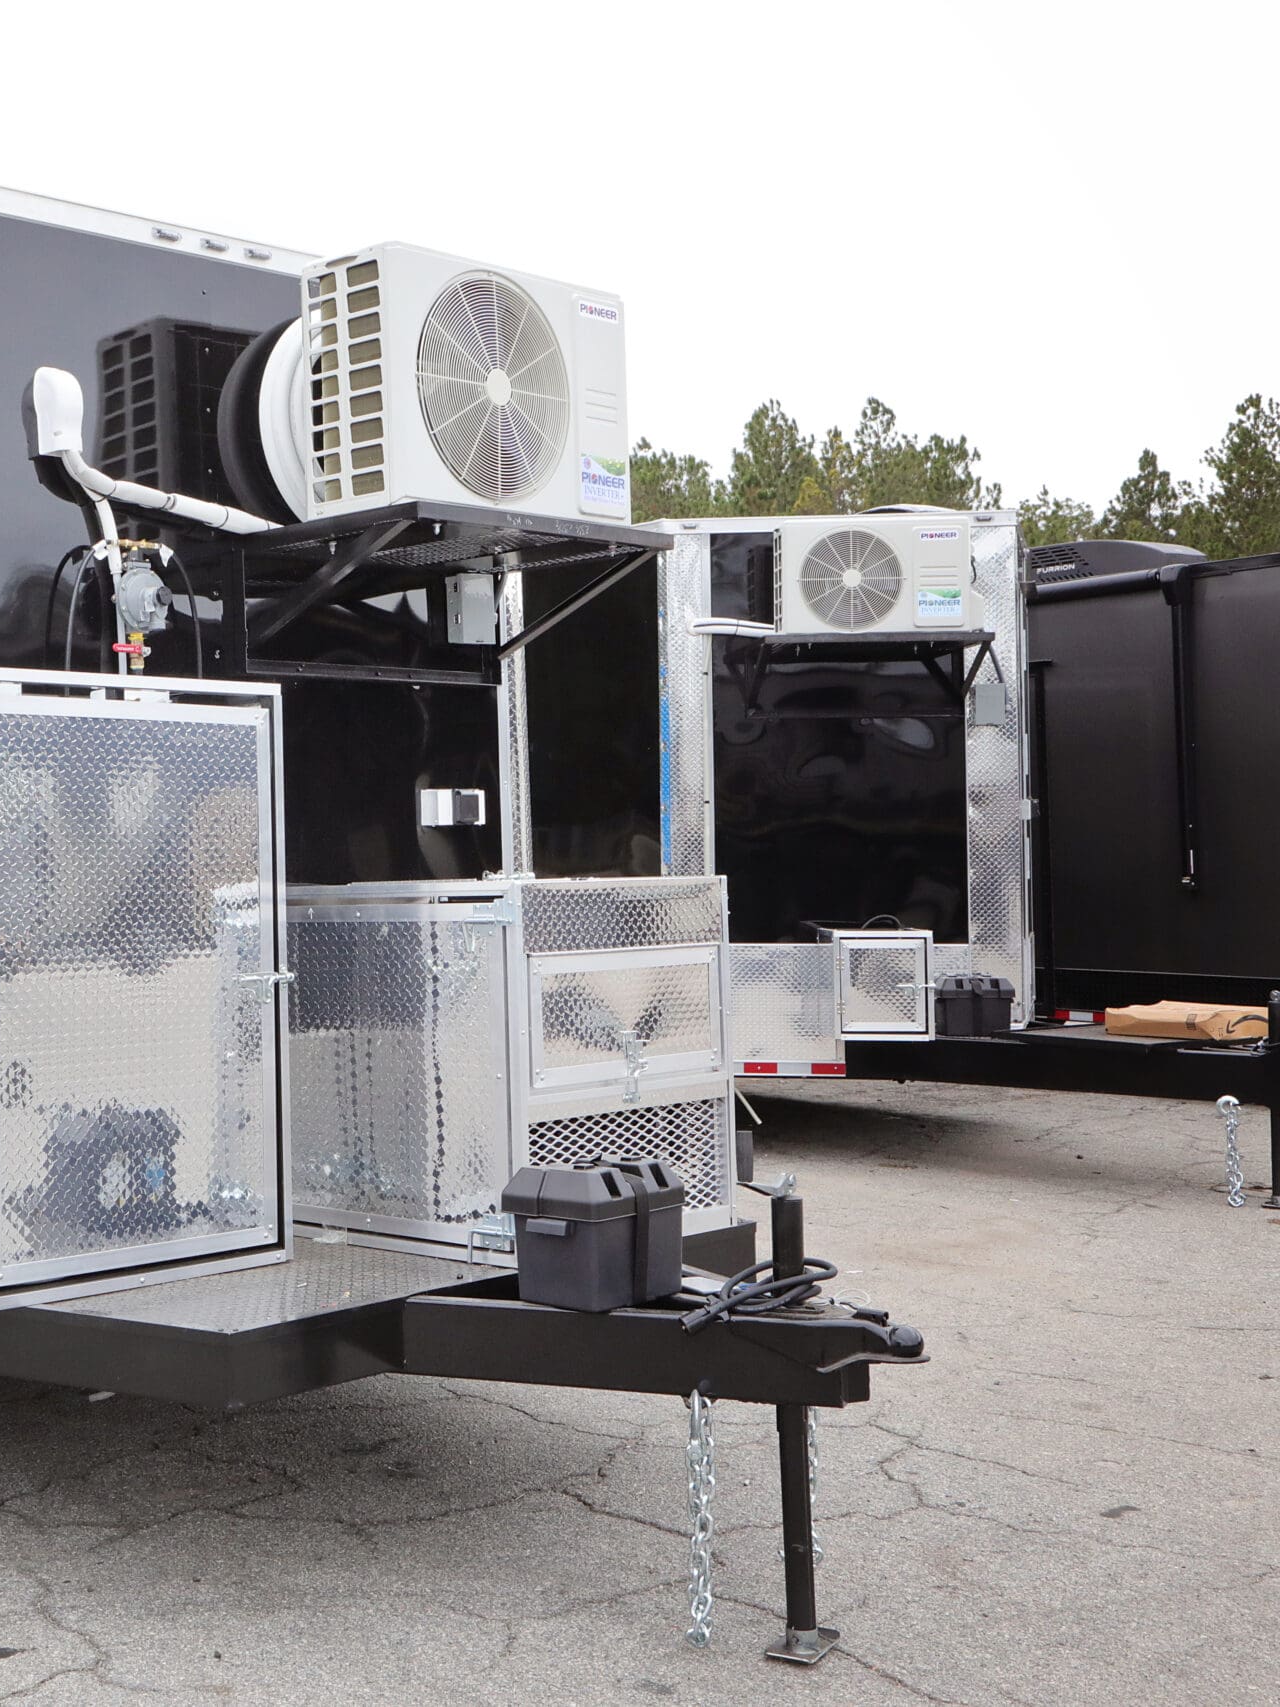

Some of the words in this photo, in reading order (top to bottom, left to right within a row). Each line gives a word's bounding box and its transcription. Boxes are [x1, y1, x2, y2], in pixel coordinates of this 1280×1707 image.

[580, 303, 617, 320] PIONEER
[581, 471, 625, 490] PIONEER
[920, 531, 957, 539] PIONEER
[1036, 562, 1075, 575] FURRION
[918, 599, 961, 607] PIONEER
